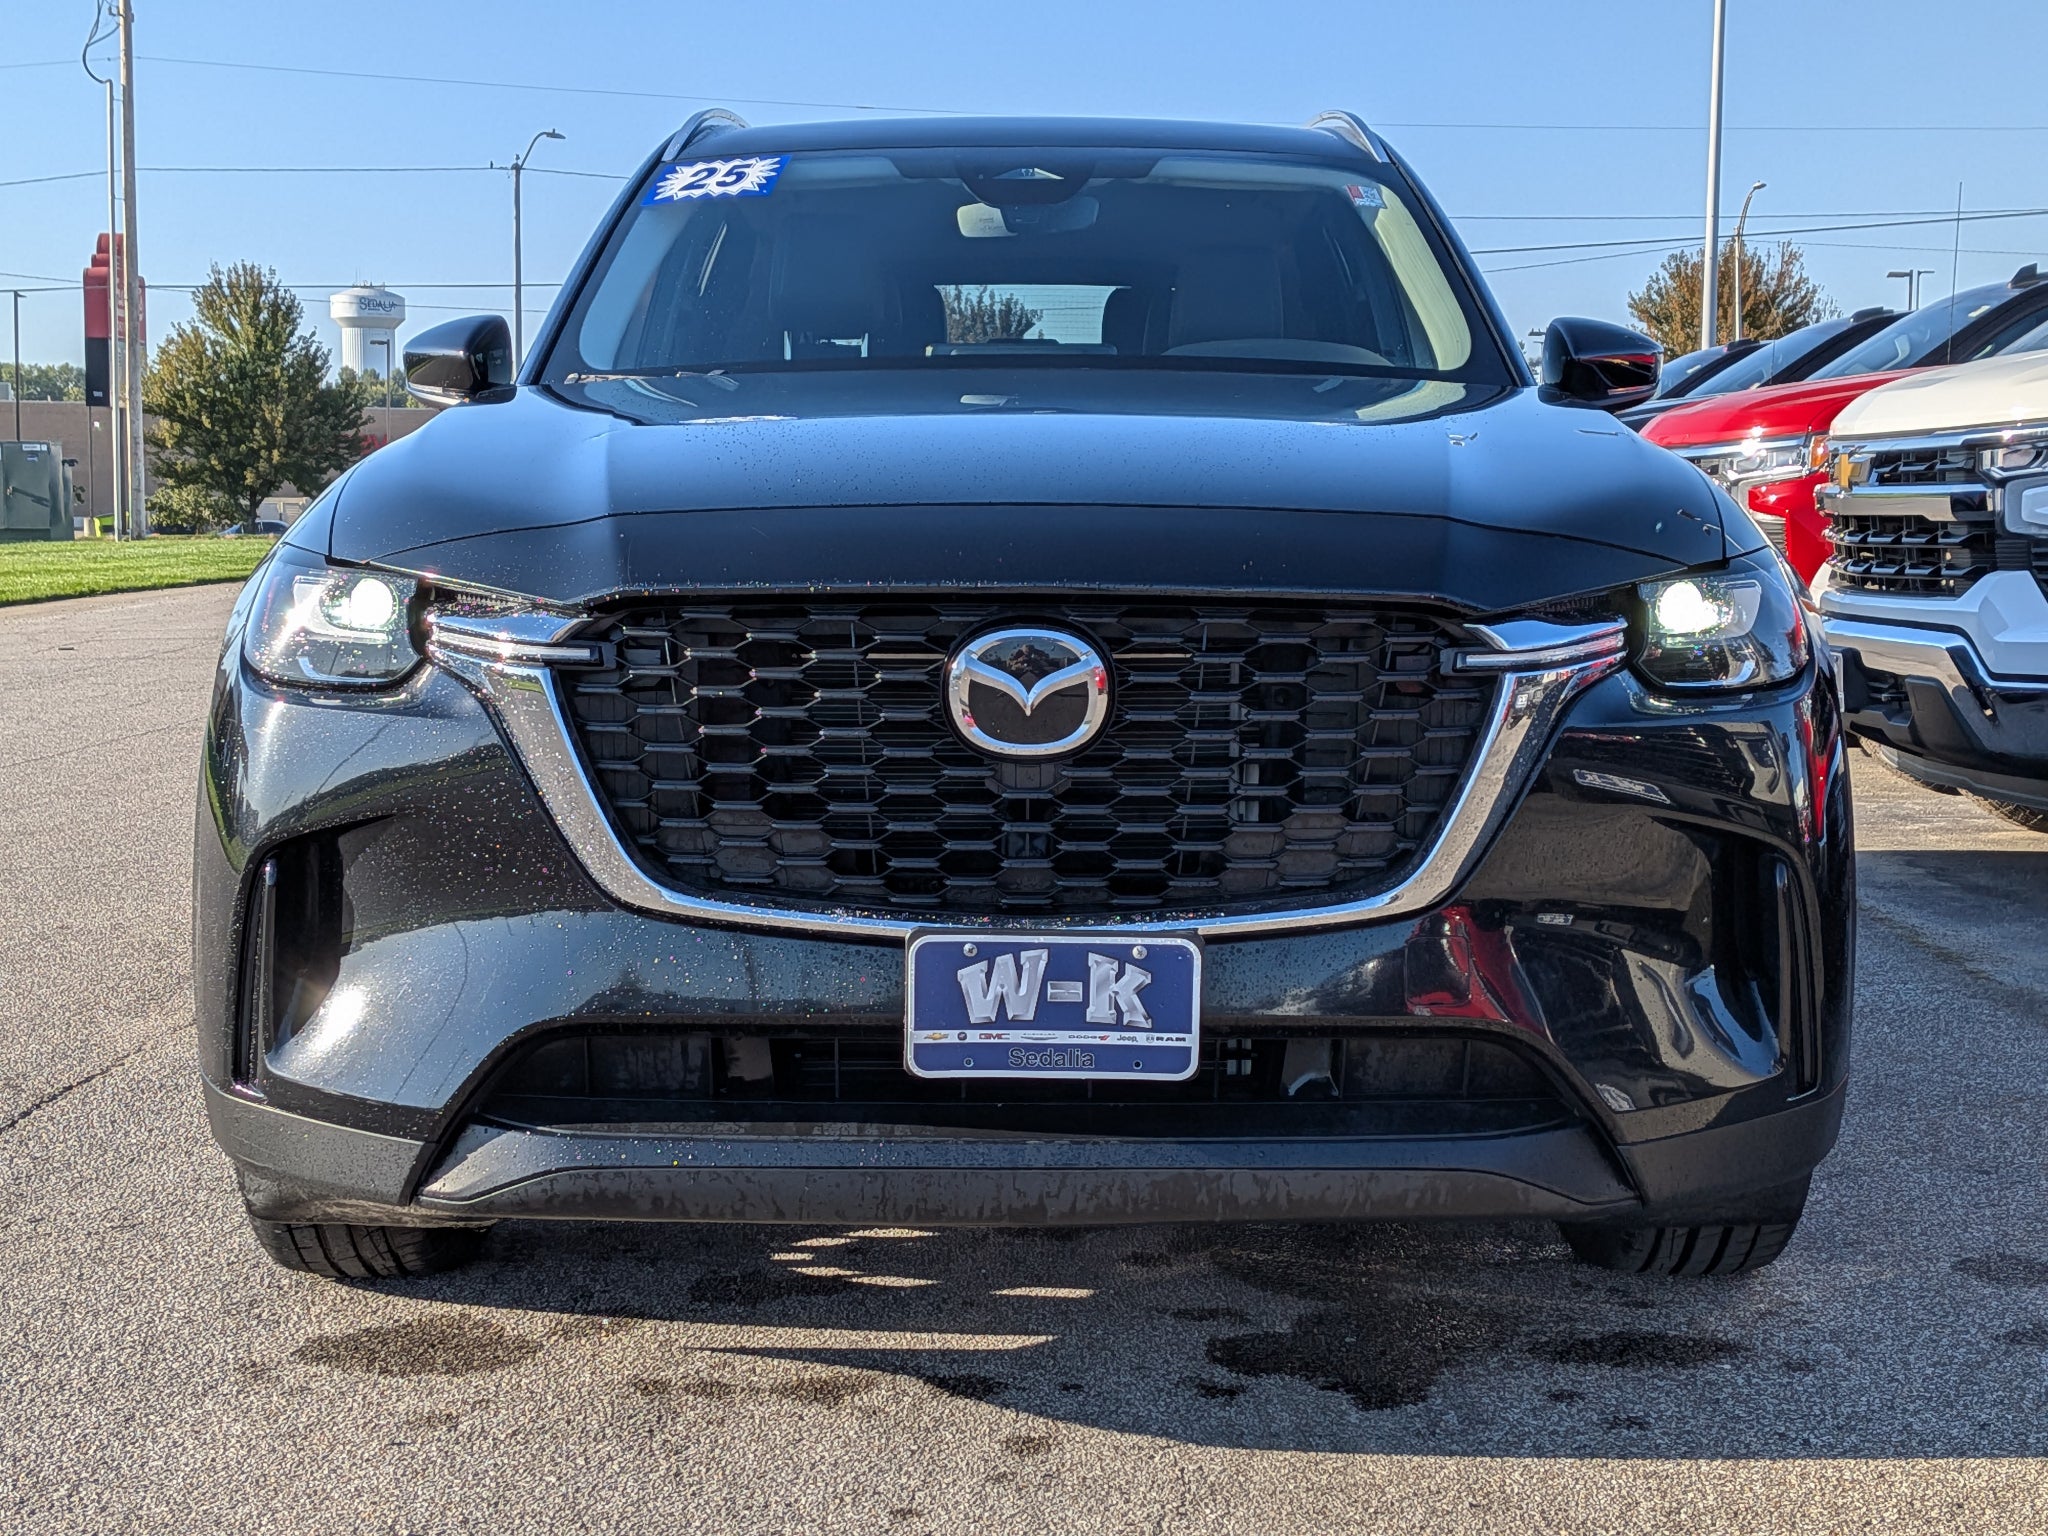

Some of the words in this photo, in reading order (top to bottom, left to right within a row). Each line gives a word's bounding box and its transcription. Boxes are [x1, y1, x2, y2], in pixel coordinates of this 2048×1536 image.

[677, 163, 754, 192] 25
[957, 949, 1152, 1029] W-K
[1008, 1047, 1095, 1069] Sedalia
